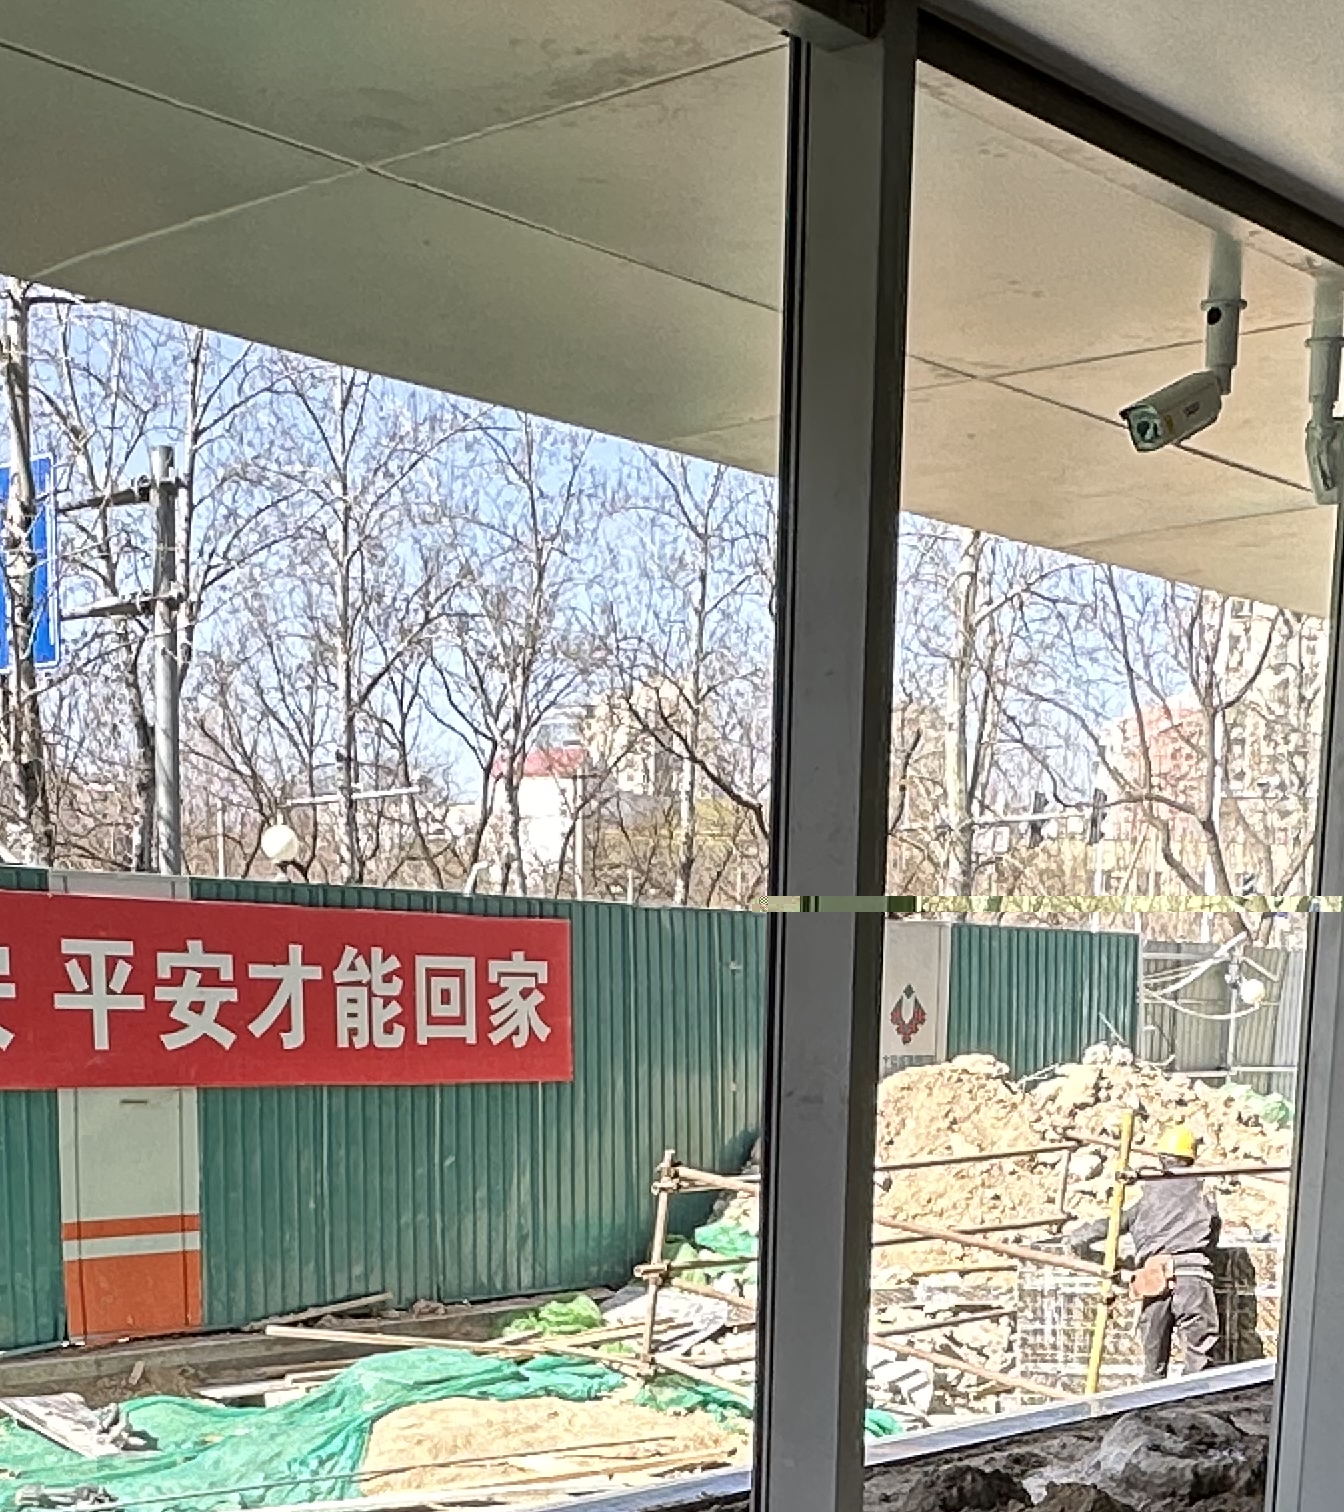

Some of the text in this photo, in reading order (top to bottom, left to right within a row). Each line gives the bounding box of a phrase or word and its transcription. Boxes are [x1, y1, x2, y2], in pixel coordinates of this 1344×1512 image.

[55, 937, 552, 1052] 平安才能回家
